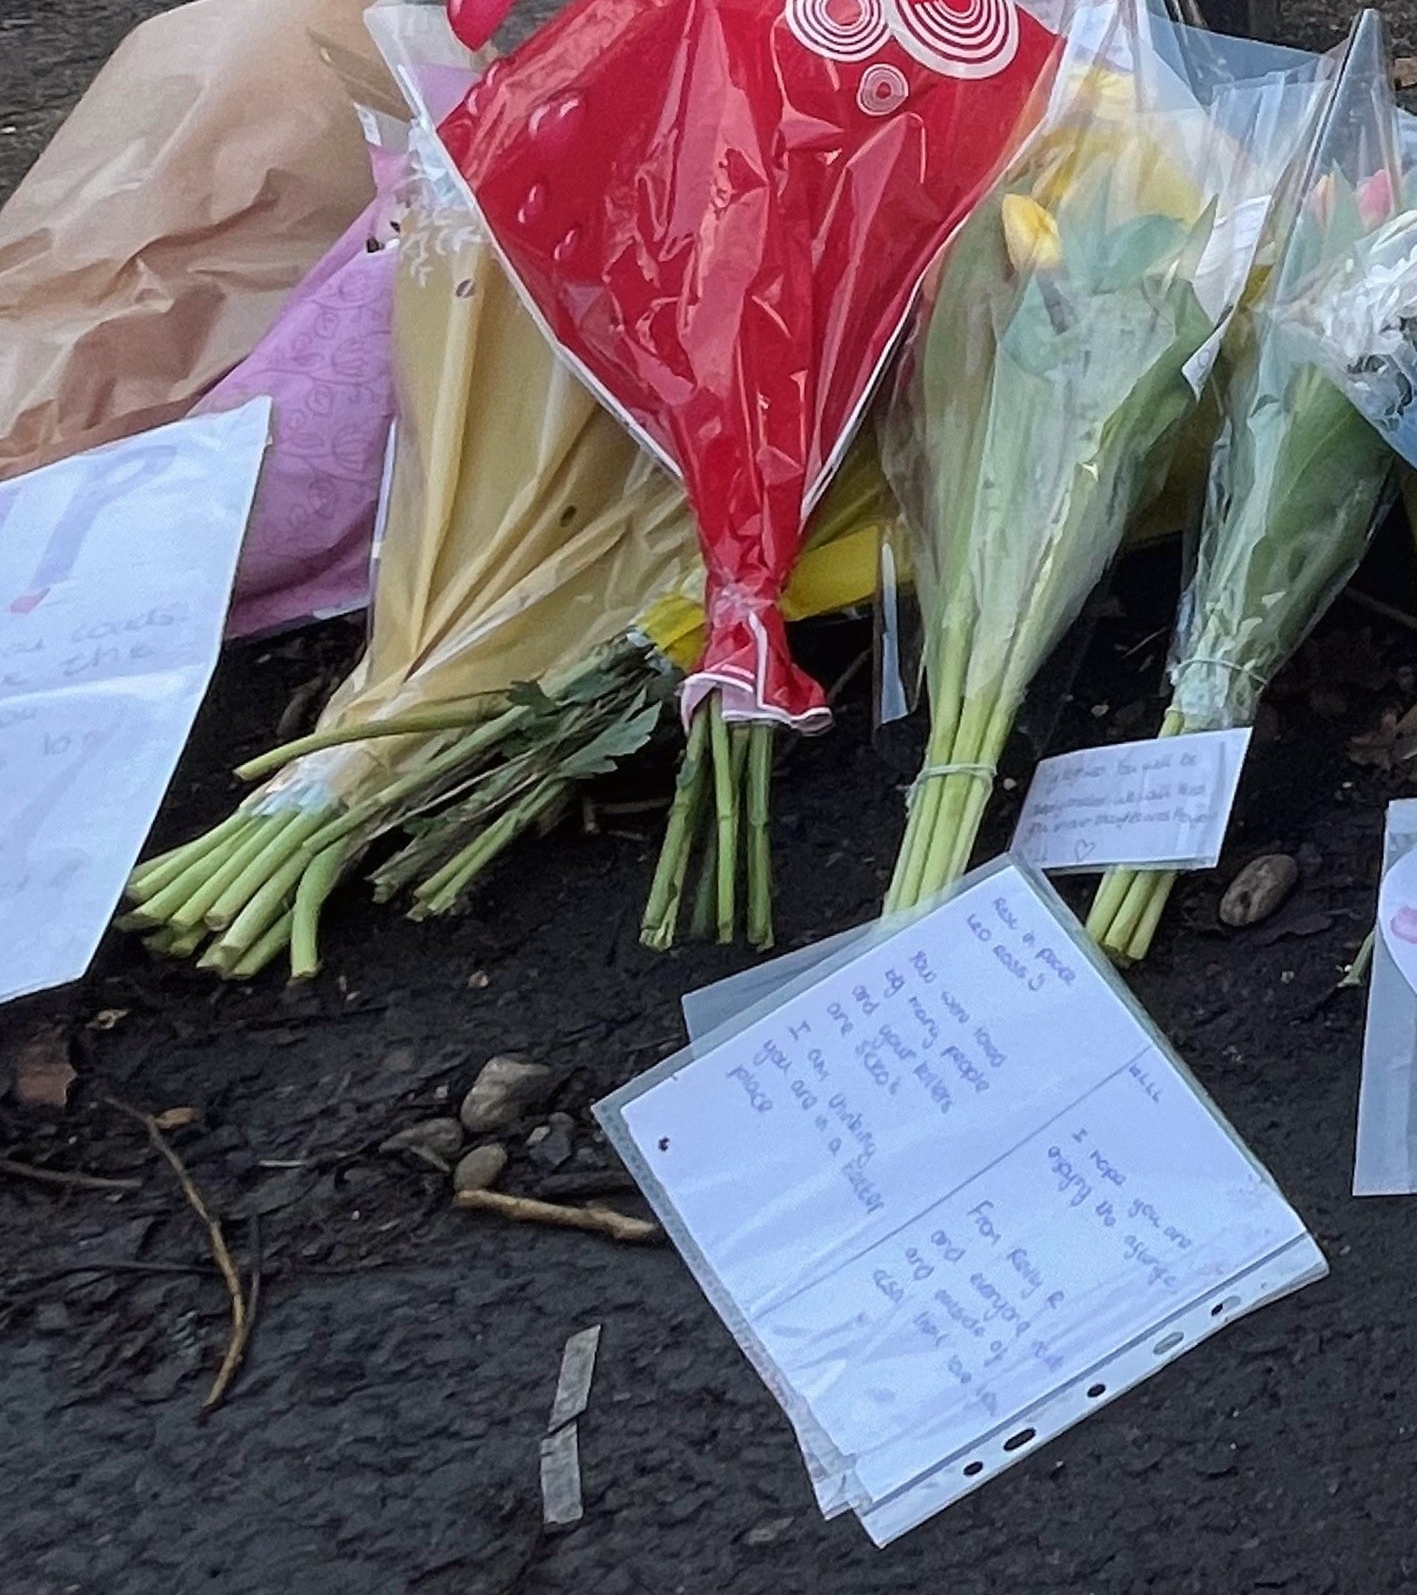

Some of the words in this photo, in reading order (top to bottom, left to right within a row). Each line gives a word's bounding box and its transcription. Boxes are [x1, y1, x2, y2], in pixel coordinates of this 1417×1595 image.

[825, 1001, 855, 1038] are
[850, 984, 881, 1017] and
[870, 1023, 917, 1062] your
[883, 967, 907, 999] by
[907, 994, 940, 1051] many
[939, 1044, 991, 1094] people
[725, 1064, 774, 1115] place
[751, 1037, 794, 1075] you
[789, 1078, 819, 1112] are
[787, 1018, 813, 1042] I
[806, 1047, 831, 1082] am
[820, 1091, 876, 1168] thinking
[1070, 1127, 1089, 1145] I
[1088, 1148, 1128, 1188] hope
[1126, 1197, 1161, 1230] you
[1162, 1225, 1194, 1251] are
[1094, 1199, 1117, 1228] the
[903, 1246, 936, 1282] and
[982, 1339, 1010, 1369] of
[929, 1228, 967, 1264] and
[968, 1271, 1033, 1340] everyone
